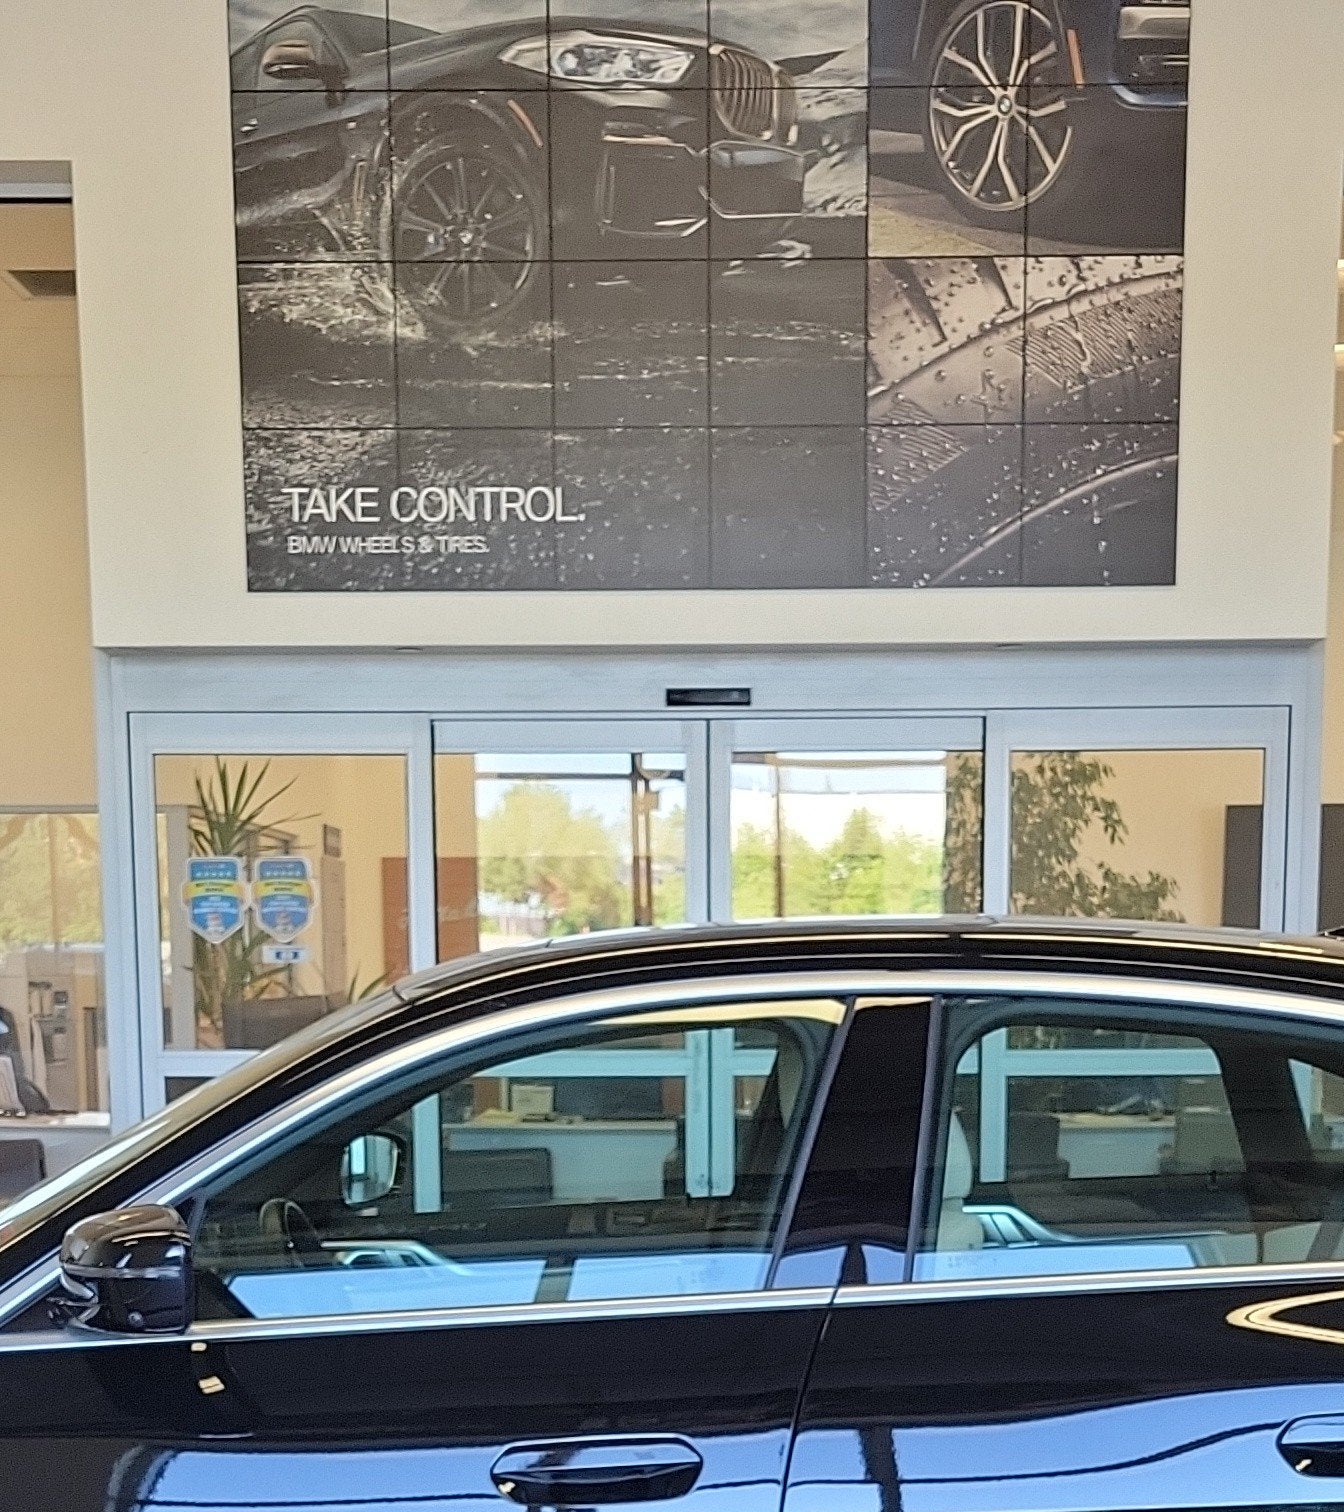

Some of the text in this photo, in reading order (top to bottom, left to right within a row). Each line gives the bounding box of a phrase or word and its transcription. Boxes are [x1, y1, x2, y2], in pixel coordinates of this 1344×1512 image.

[281, 486, 586, 523] TAKE CONTROL.
[286, 535, 337, 554] BMW
[338, 535, 416, 554] WHEELS
[417, 535, 434, 554] &
